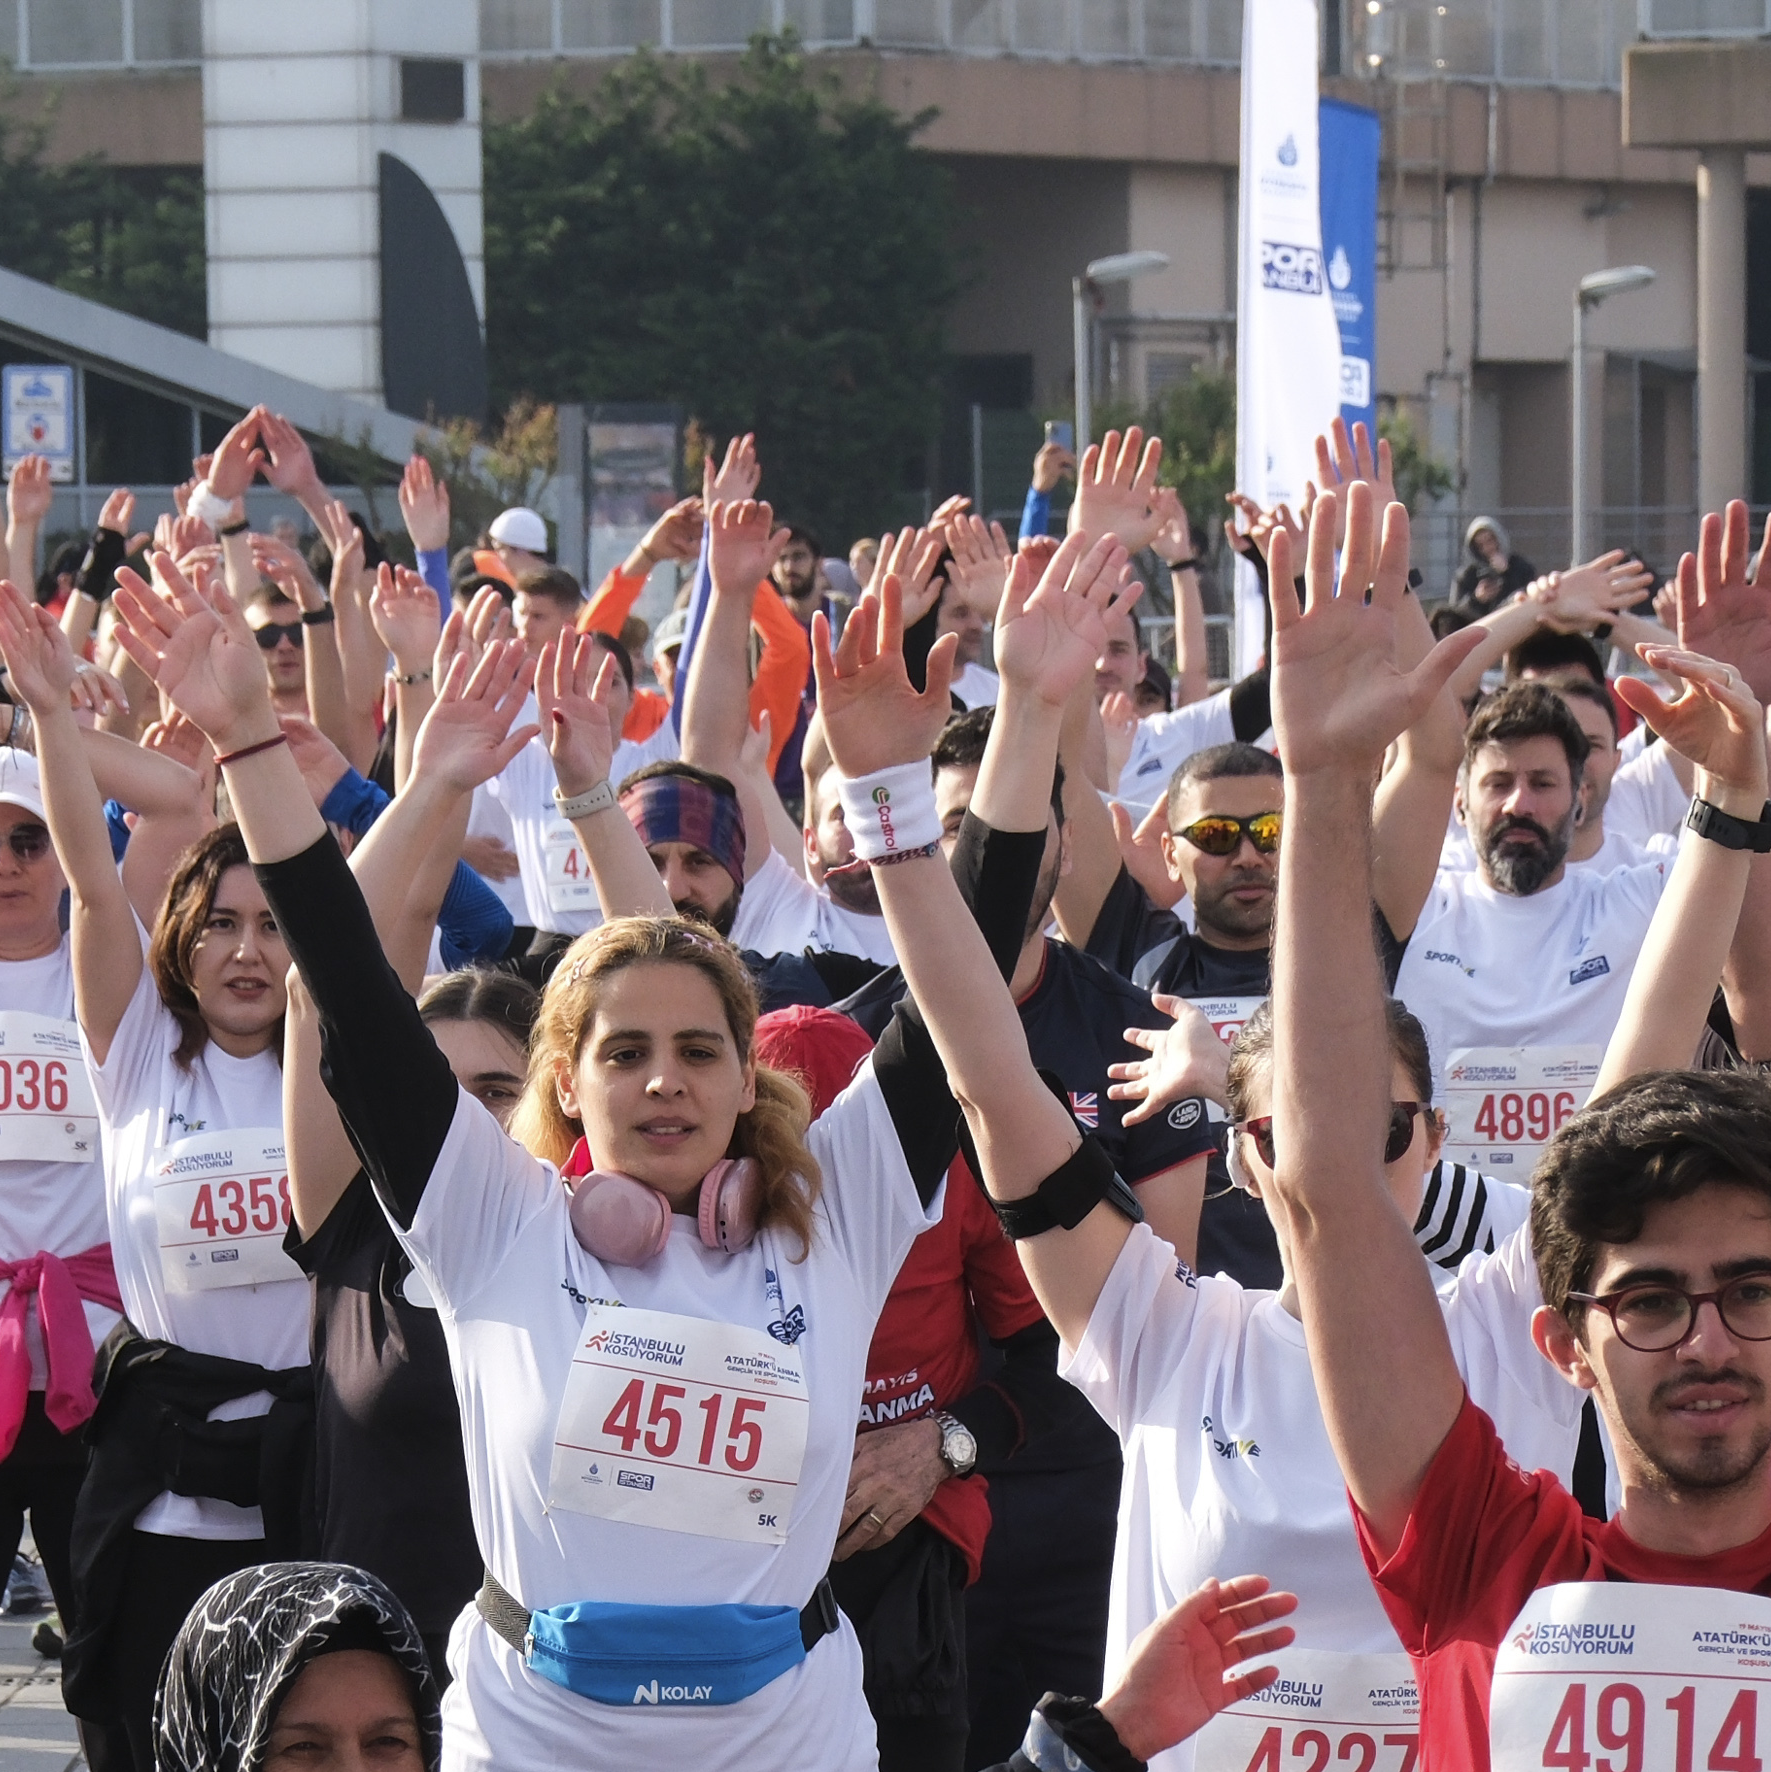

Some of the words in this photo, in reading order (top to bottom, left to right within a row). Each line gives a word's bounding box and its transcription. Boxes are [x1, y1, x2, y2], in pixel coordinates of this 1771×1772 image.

[877, 804, 899, 852] Castrol
[1474, 1091, 1575, 1142] 4896
[609, 1330, 686, 1356] İSTANBULU
[724, 1354, 777, 1372] ATATÜRK'Ü
[859, 1383, 934, 1426] ANMA
[601, 1378, 767, 1472] 4515
[619, 1472, 651, 1485] SPOR
[758, 1513, 778, 1528] 5K
[1534, 1621, 1636, 1640] İSTANBULU
[1692, 1630, 1771, 1648] ATATÜRK'Ü
[1697, 1645, 1735, 1656] GENÇLİK
[1736, 1647, 1748, 1655] VE
[1749, 1648, 1771, 1658] SPOR
[661, 1686, 713, 1702] KOLAY
